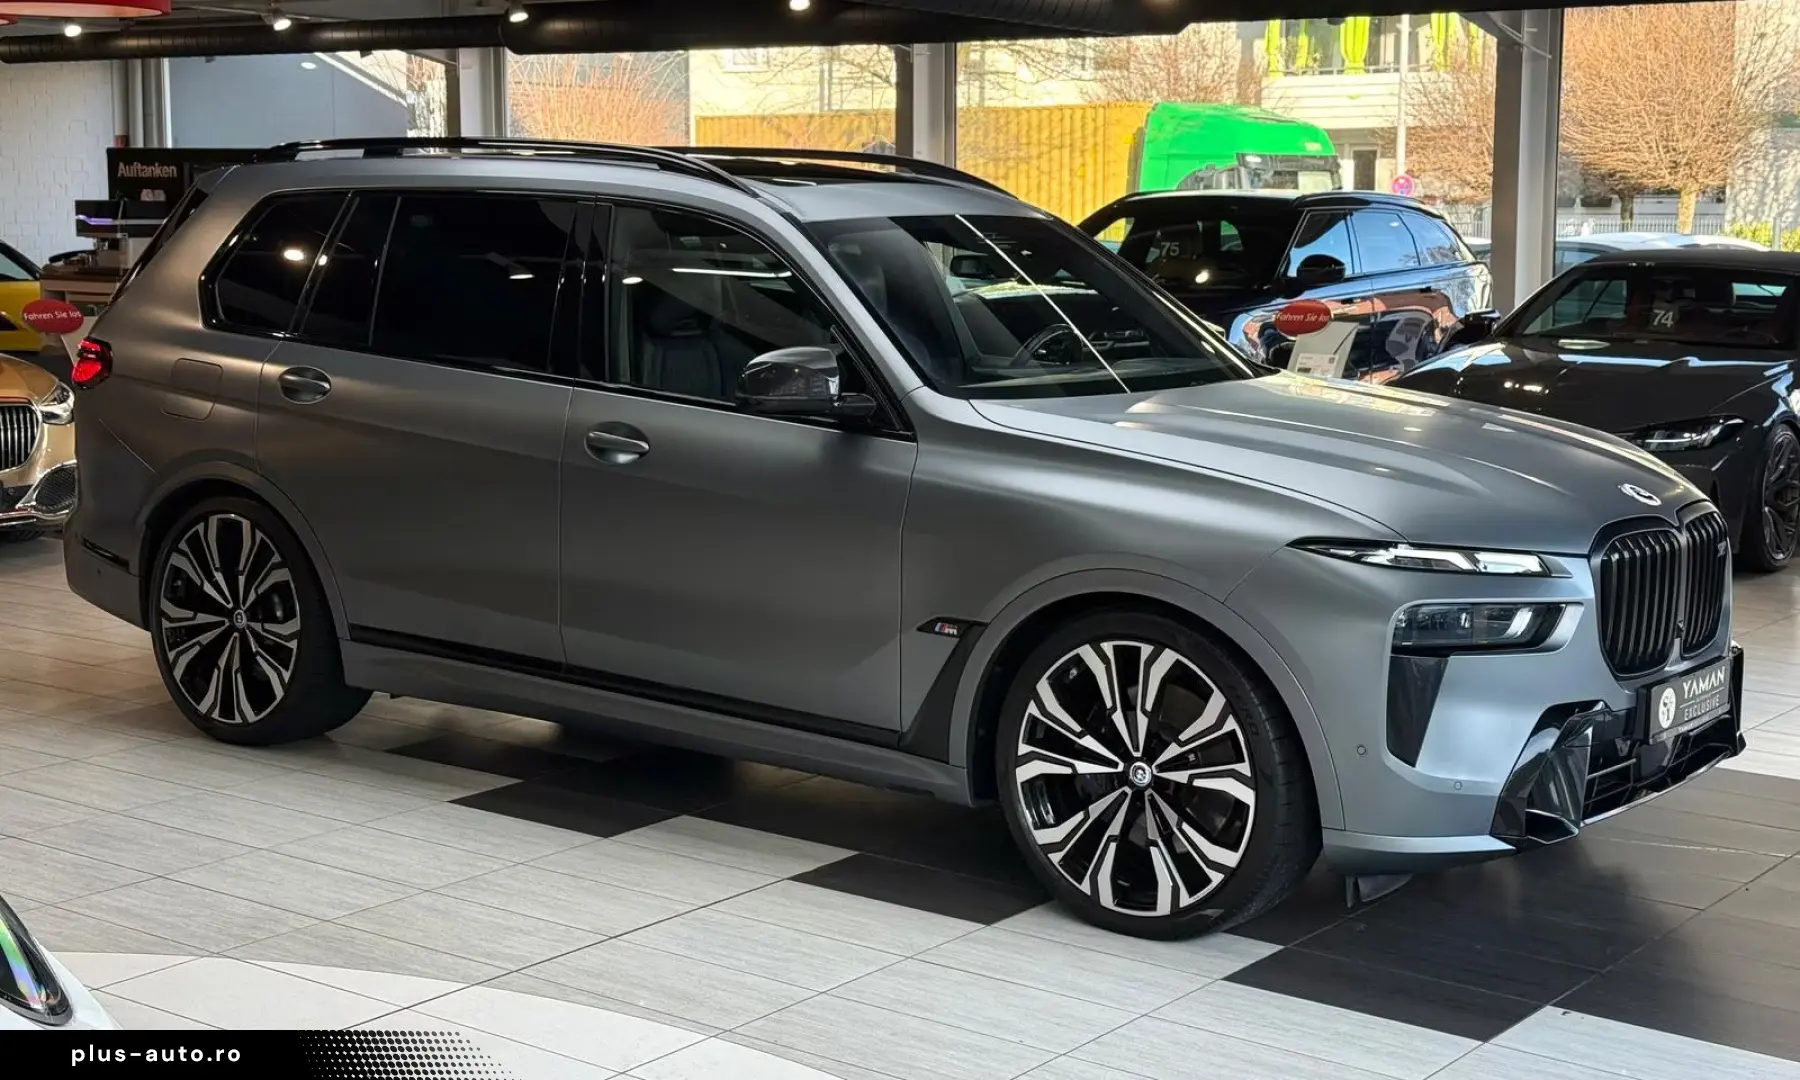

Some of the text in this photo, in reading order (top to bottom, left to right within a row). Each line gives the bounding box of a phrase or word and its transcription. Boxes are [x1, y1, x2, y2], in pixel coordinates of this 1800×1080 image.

[117, 162, 178, 178] Auftanken
[1161, 242, 1180, 257] 75
[23, 312, 54, 321] Fahren
[54, 310, 69, 319] Sie
[1276, 312, 1304, 321] Fahren
[1305, 312, 1318, 321] Sie
[1653, 309, 1674, 328] 74
[1682, 665, 1727, 699] YAMAN
